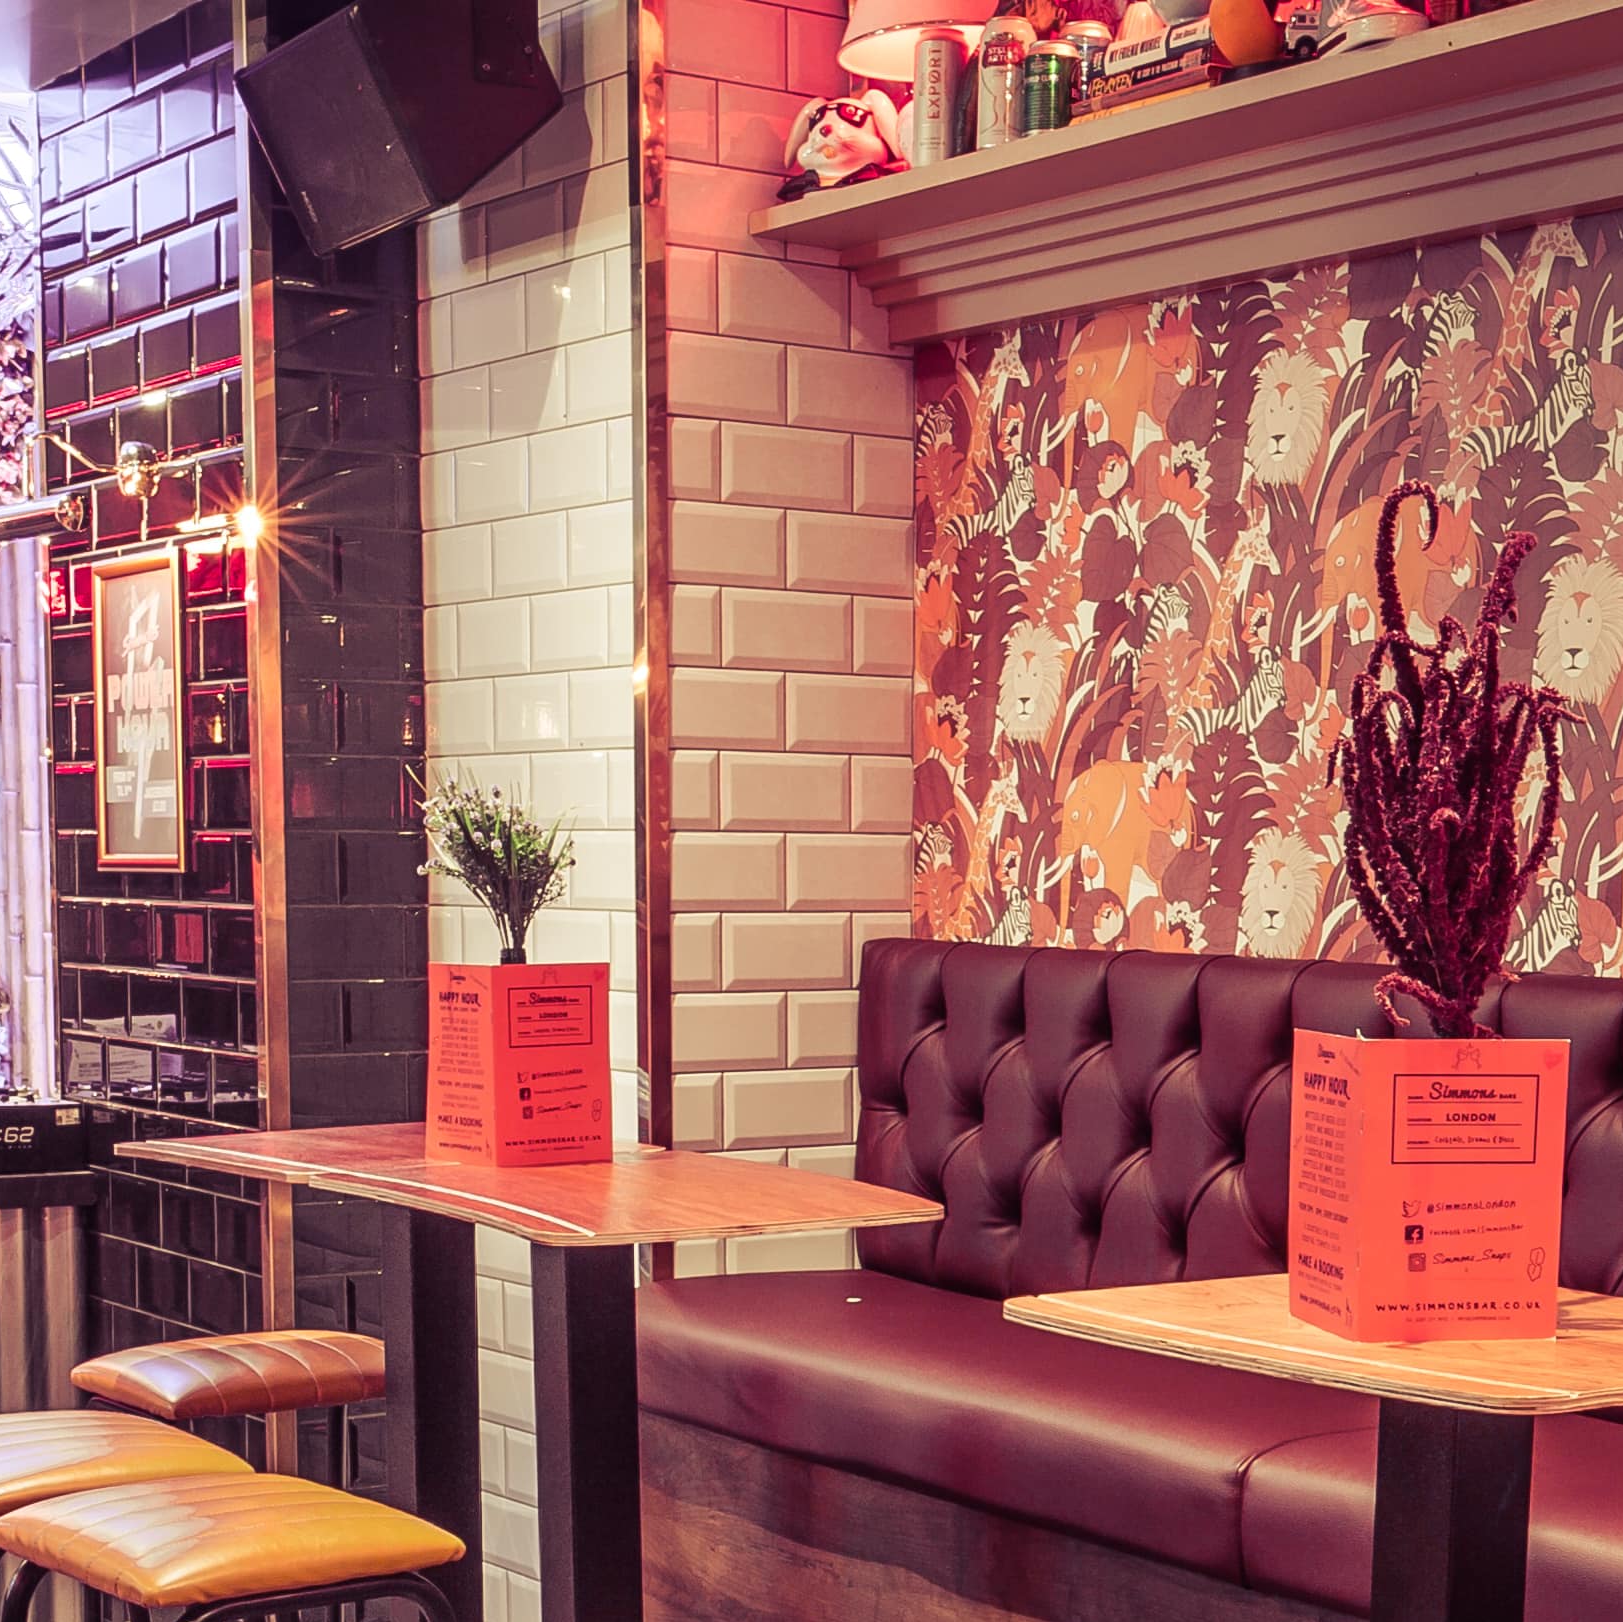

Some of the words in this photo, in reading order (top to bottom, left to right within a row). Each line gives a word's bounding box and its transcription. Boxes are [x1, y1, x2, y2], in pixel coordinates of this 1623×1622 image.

[1304, 1071, 1327, 1092] HAPPY
[1328, 1076, 1351, 1101] HOUR
[1429, 1081, 1497, 1100] Simmons
[1446, 1112, 1497, 1122] LONDON
